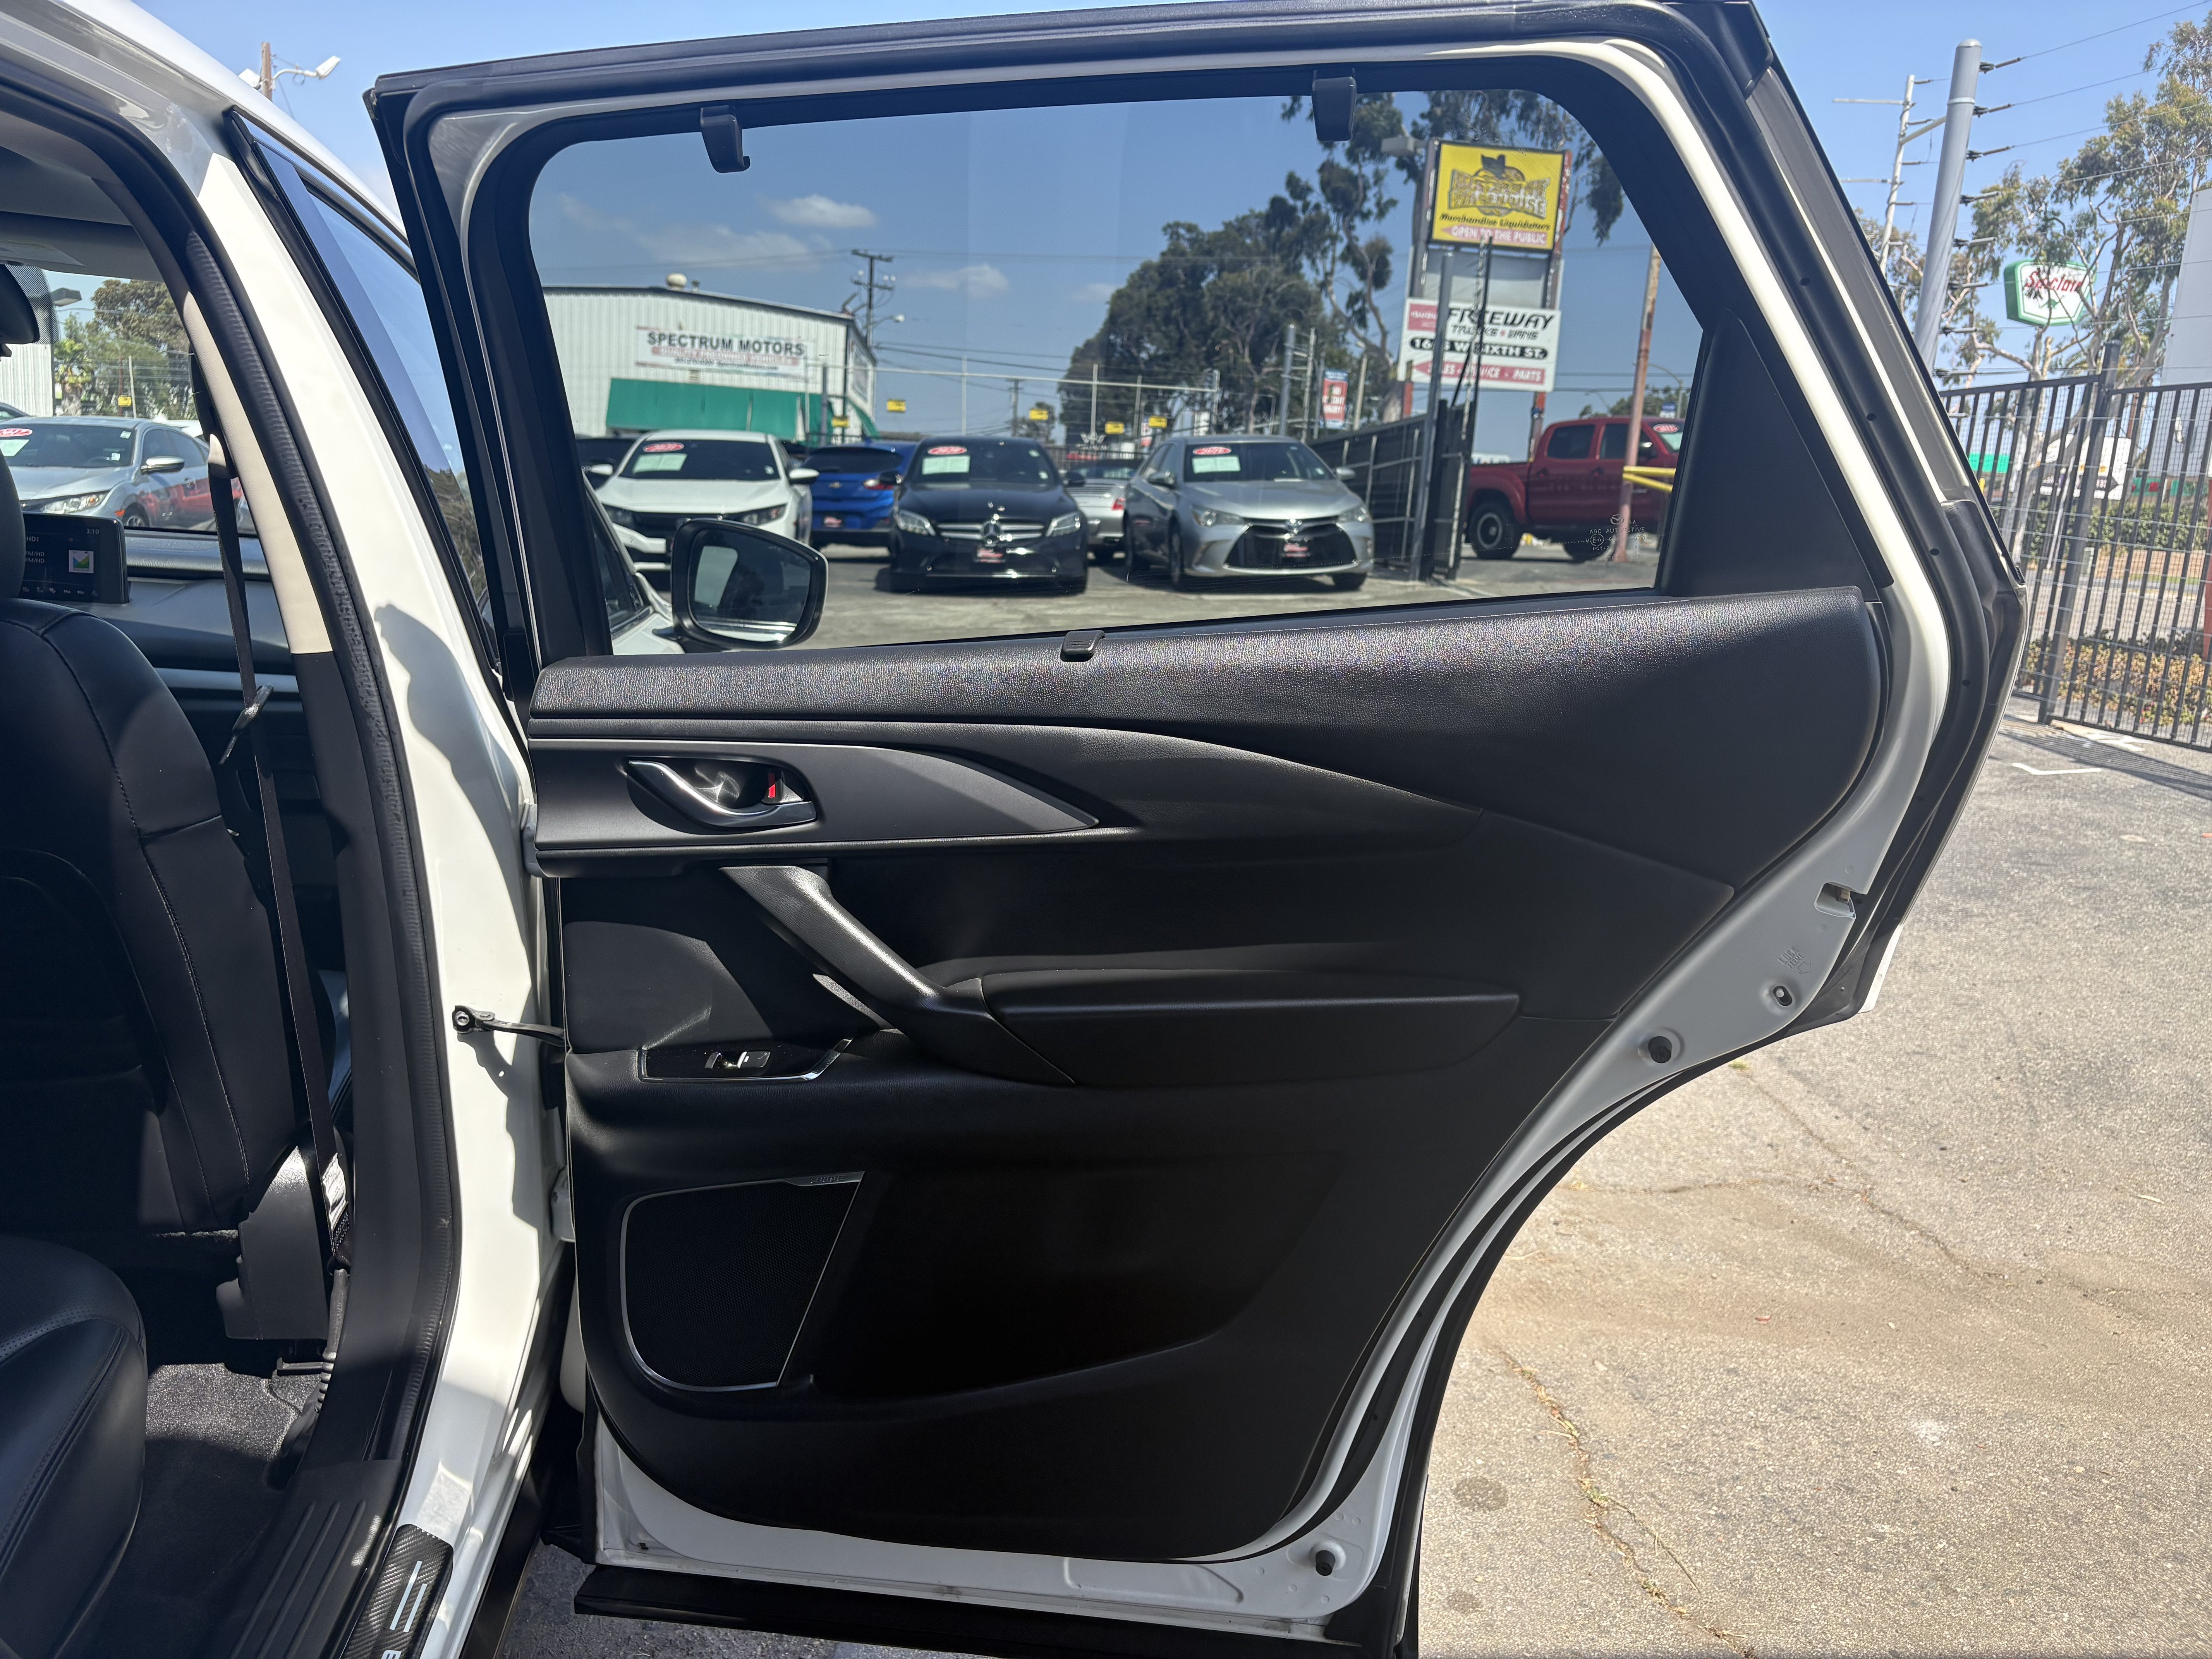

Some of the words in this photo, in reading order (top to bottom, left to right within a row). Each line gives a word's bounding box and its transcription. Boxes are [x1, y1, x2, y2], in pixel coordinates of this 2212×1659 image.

[1451, 225, 1478, 238] OPEN
[1494, 229, 1512, 241] THE
[1513, 231, 1546, 244] PUBLIC
[1449, 308, 1553, 331] FREWAY
[647, 332, 733, 350] SPECTRUM
[739, 339, 805, 356] MOTORS
